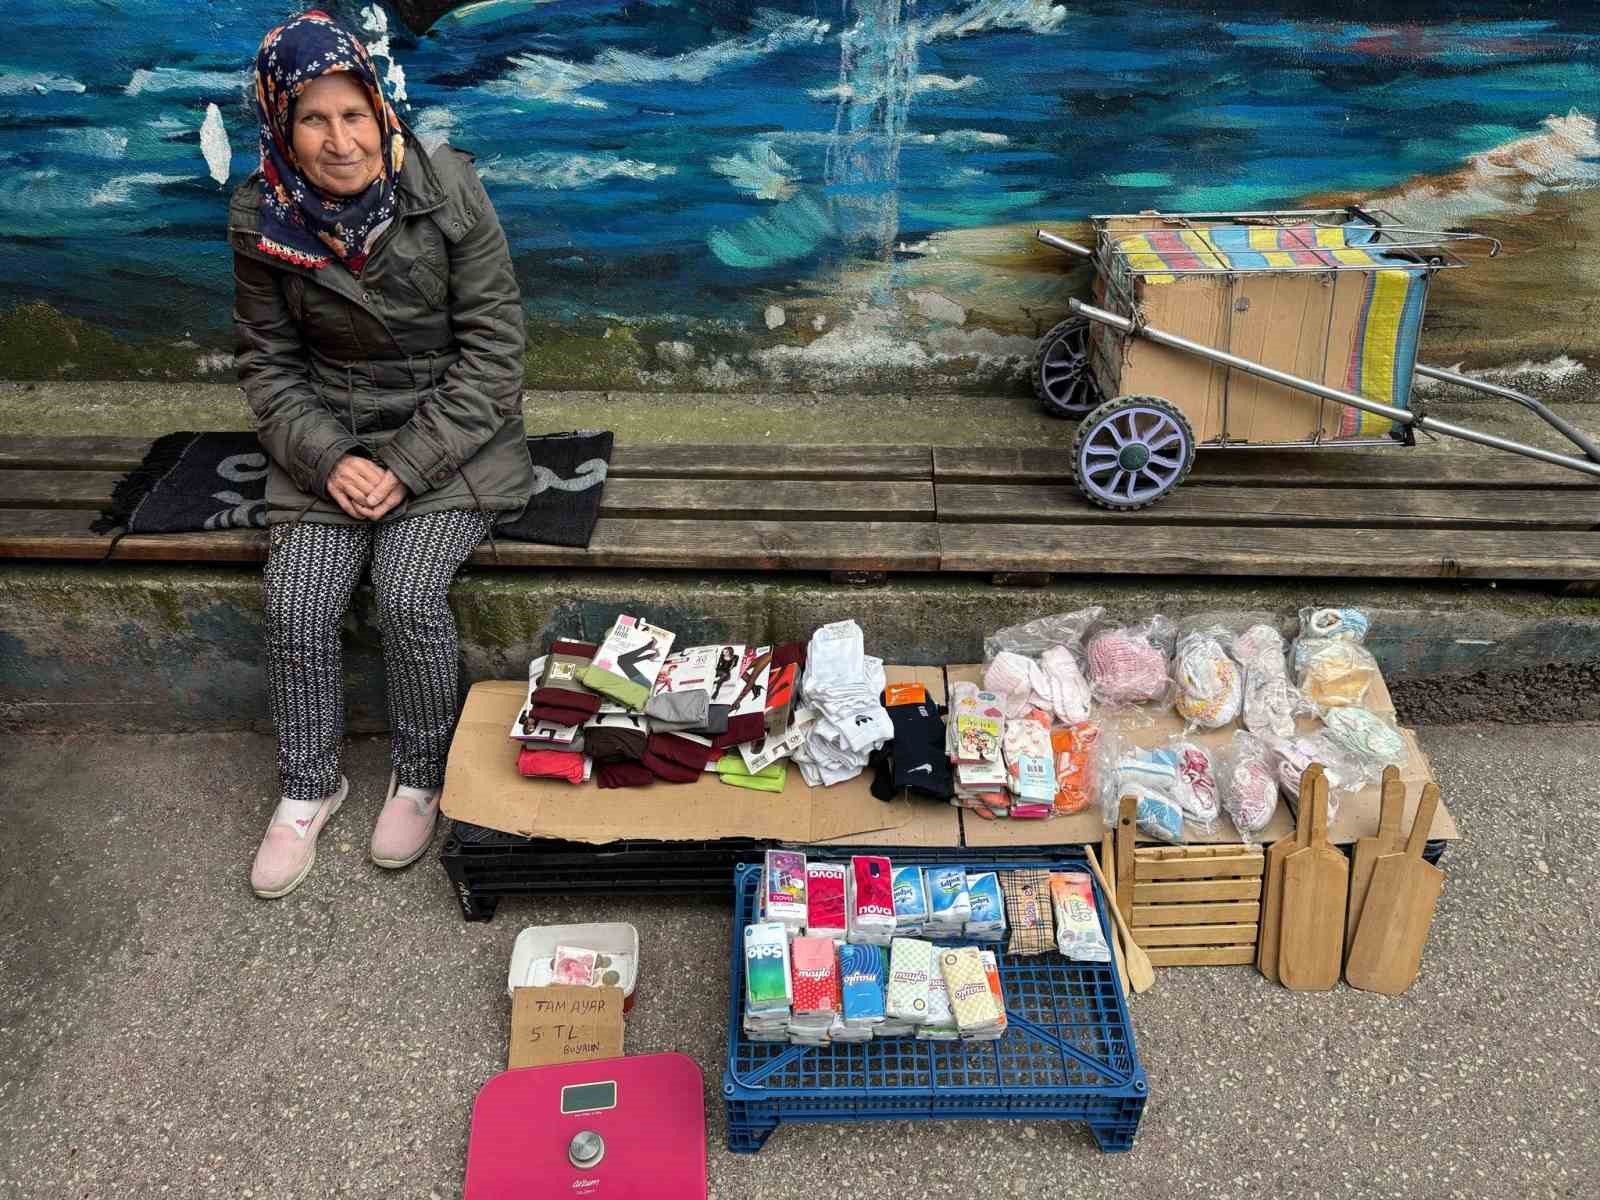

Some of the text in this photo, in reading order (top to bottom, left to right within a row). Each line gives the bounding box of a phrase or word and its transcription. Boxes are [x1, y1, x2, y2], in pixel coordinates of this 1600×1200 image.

[858, 904, 892, 915] nova
[798, 968, 831, 981] maylo
[843, 972, 876, 986] maylo
[535, 1000, 608, 1015] TAM AYAR
[529, 1024, 578, 1042] 5 TL
